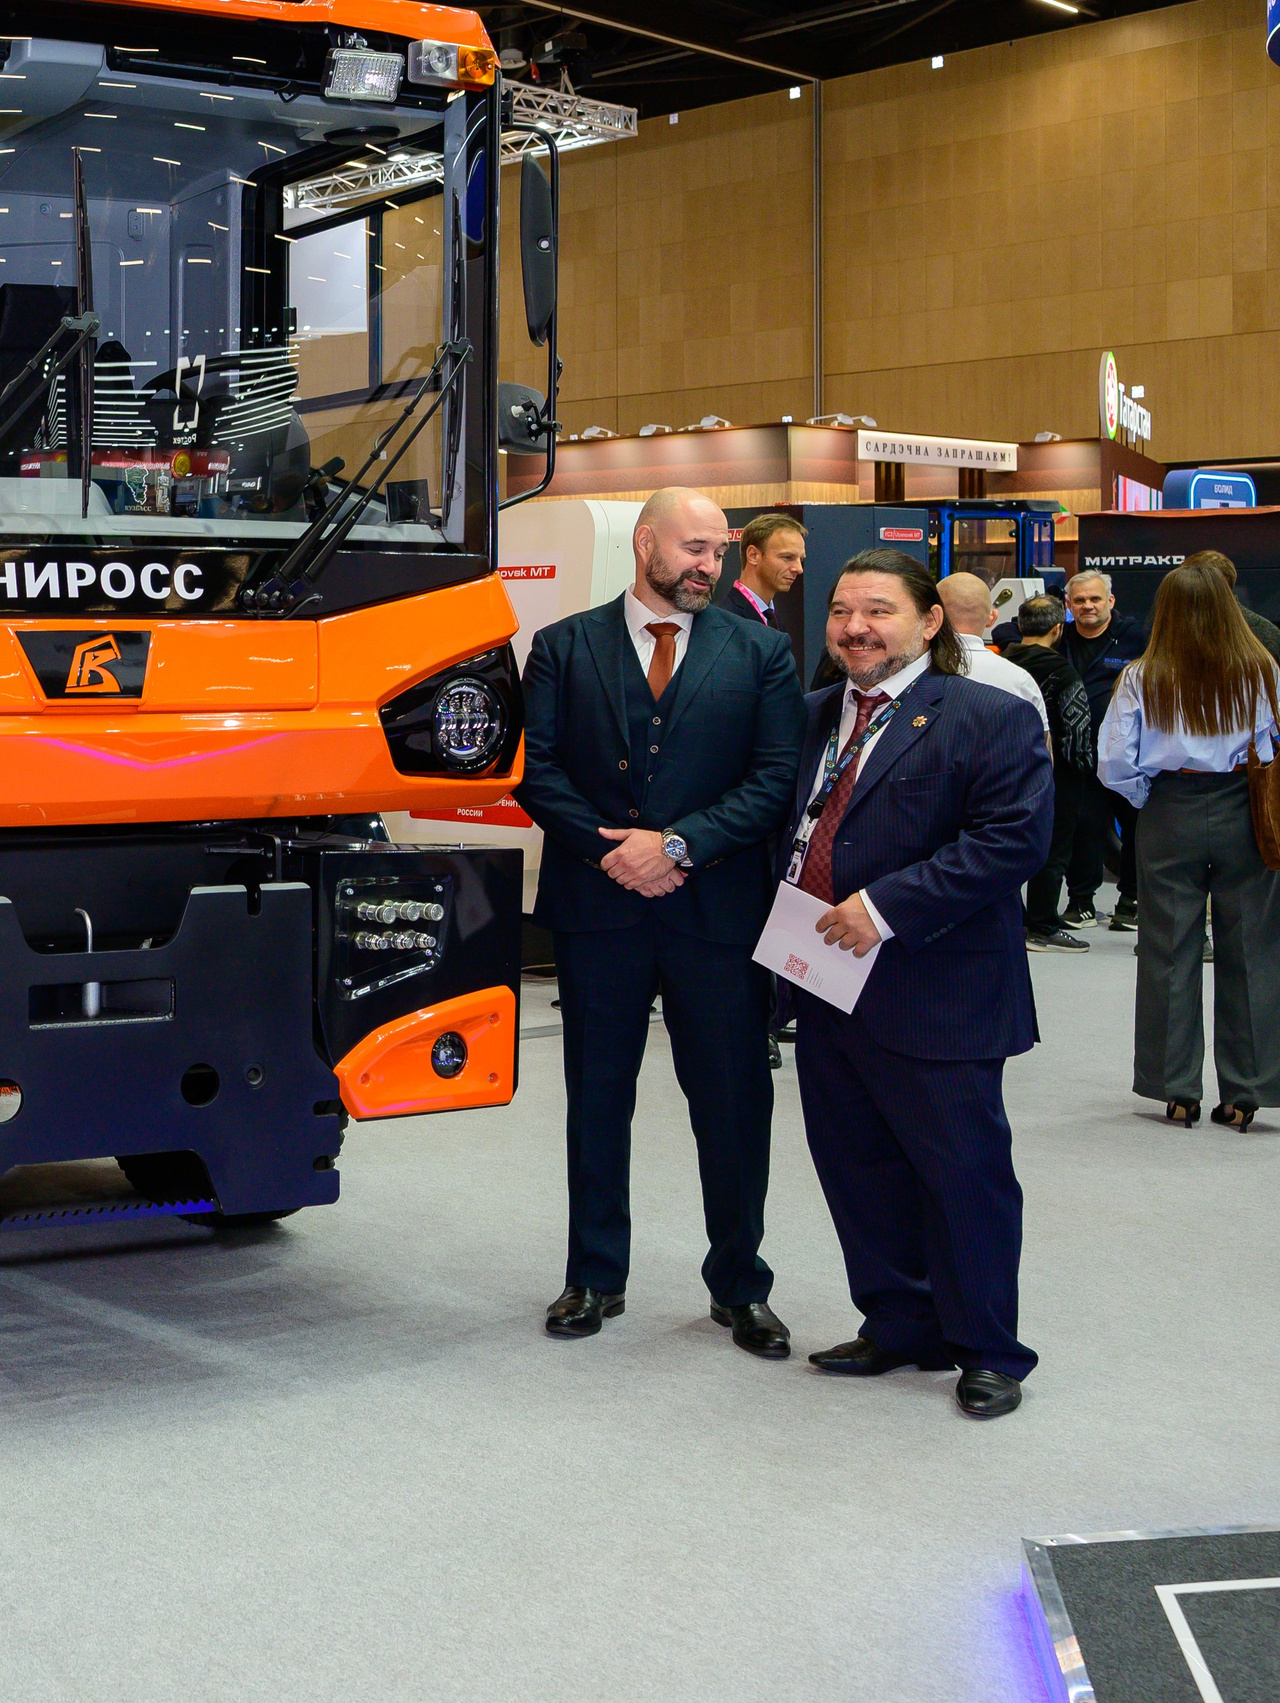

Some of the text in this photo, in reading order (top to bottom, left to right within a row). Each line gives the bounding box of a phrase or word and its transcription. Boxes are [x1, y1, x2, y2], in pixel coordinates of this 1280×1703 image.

[1118, 382, 1152, 443] Татарстан
[865, 441, 1011, 463] САРДЭЧНА ЗАПРАШАЕМ!
[530, 567, 551, 577] MT
[457, 808, 483, 817] РОССИИ
